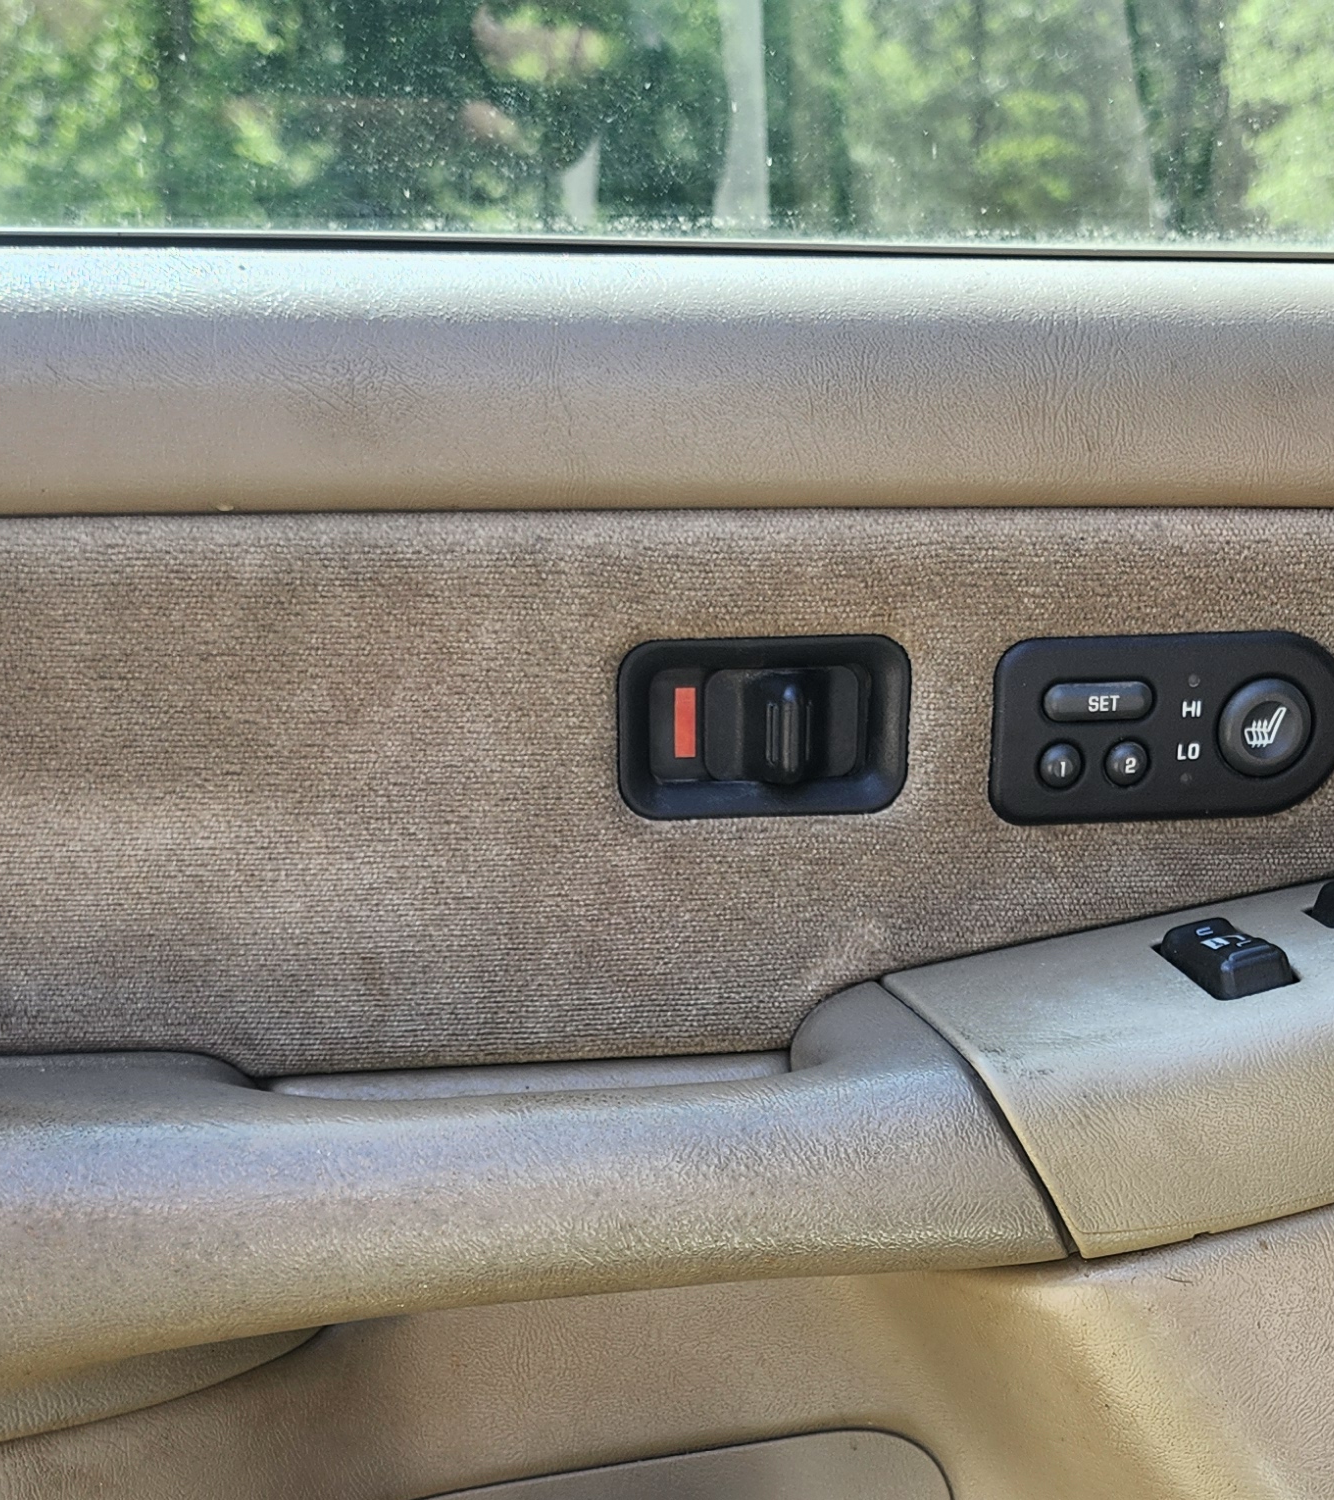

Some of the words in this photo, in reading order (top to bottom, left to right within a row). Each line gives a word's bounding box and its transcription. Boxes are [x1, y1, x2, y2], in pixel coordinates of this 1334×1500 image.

[1088, 695, 1120, 712] SET
[1182, 700, 1202, 718] HI
[1177, 743, 1200, 761] LO
[1060, 761, 1066, 778] 1
[1124, 757, 1137, 774] 2
[1195, 926, 1214, 937] U
